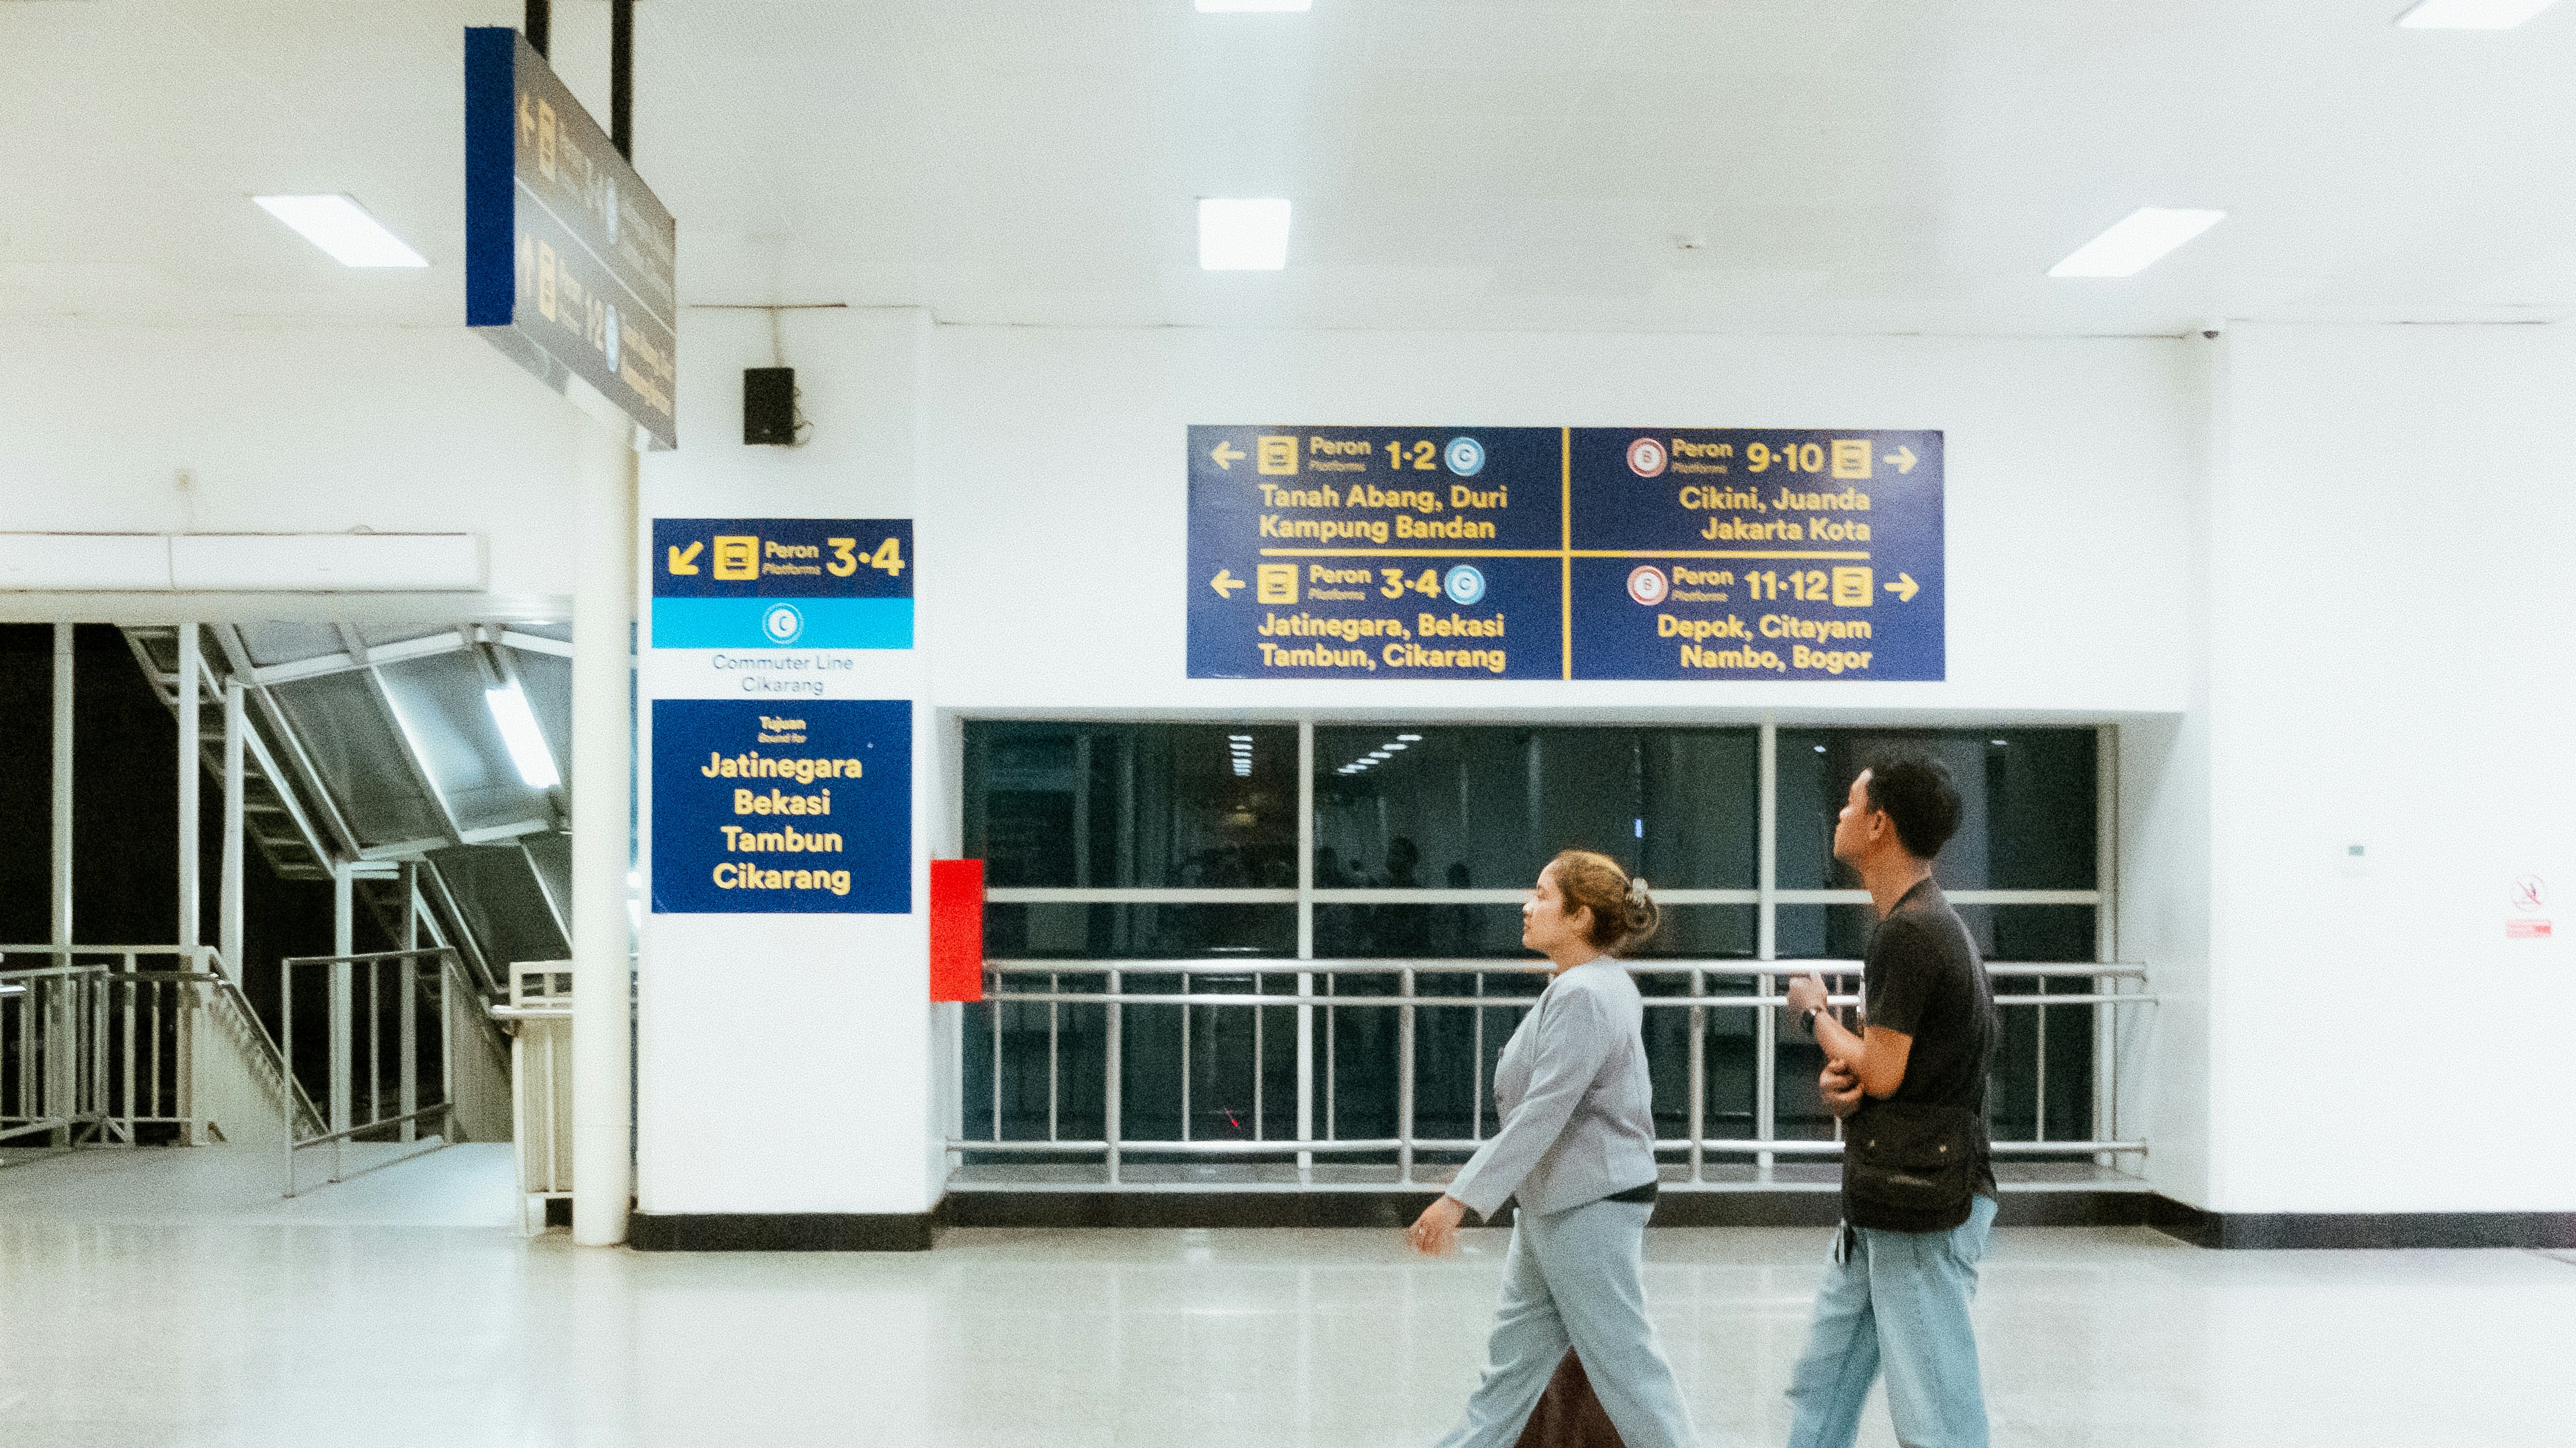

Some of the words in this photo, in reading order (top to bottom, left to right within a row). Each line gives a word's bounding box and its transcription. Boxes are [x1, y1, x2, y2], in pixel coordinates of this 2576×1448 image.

[1309, 437, 1371, 455] Peron
[1672, 439, 1732, 459] Peron
[1259, 484, 1338, 508] Tanah
[1345, 484, 1443, 513] Abang,
[1450, 485, 1508, 508] Duri
[1679, 486, 1766, 513] Cikini,
[1772, 487, 1871, 510] Juanda
[1260, 515, 1388, 543] Kampung
[1396, 515, 1496, 539] Bandan
[1701, 518, 1803, 541] Jakarta
[1810, 518, 1871, 541] Kota
[765, 542, 819, 559] Peron
[1309, 565, 1371, 584] Peron
[1672, 567, 1734, 586] Peron
[1259, 613, 1410, 642] Jatinegara,
[1419, 613, 1504, 637] Bekasi
[1658, 614, 1753, 642] Depok,
[1759, 614, 1871, 644] Citayam
[713, 654, 810, 671] Commuter
[816, 654, 853, 671] Line
[1258, 643, 1375, 671] Tambun,
[1382, 643, 1506, 673] Cikarang
[1680, 645, 1786, 672] Nambo,
[1793, 645, 1872, 674] Bogor
[742, 677, 824, 695] Cikarang
[759, 716, 806, 732] Tujuan
[701, 751, 862, 785] Jatinegara
[734, 788, 831, 816] Bekasi
[721, 825, 843, 853] Tambun
[712, 862, 851, 896] Cikarang
